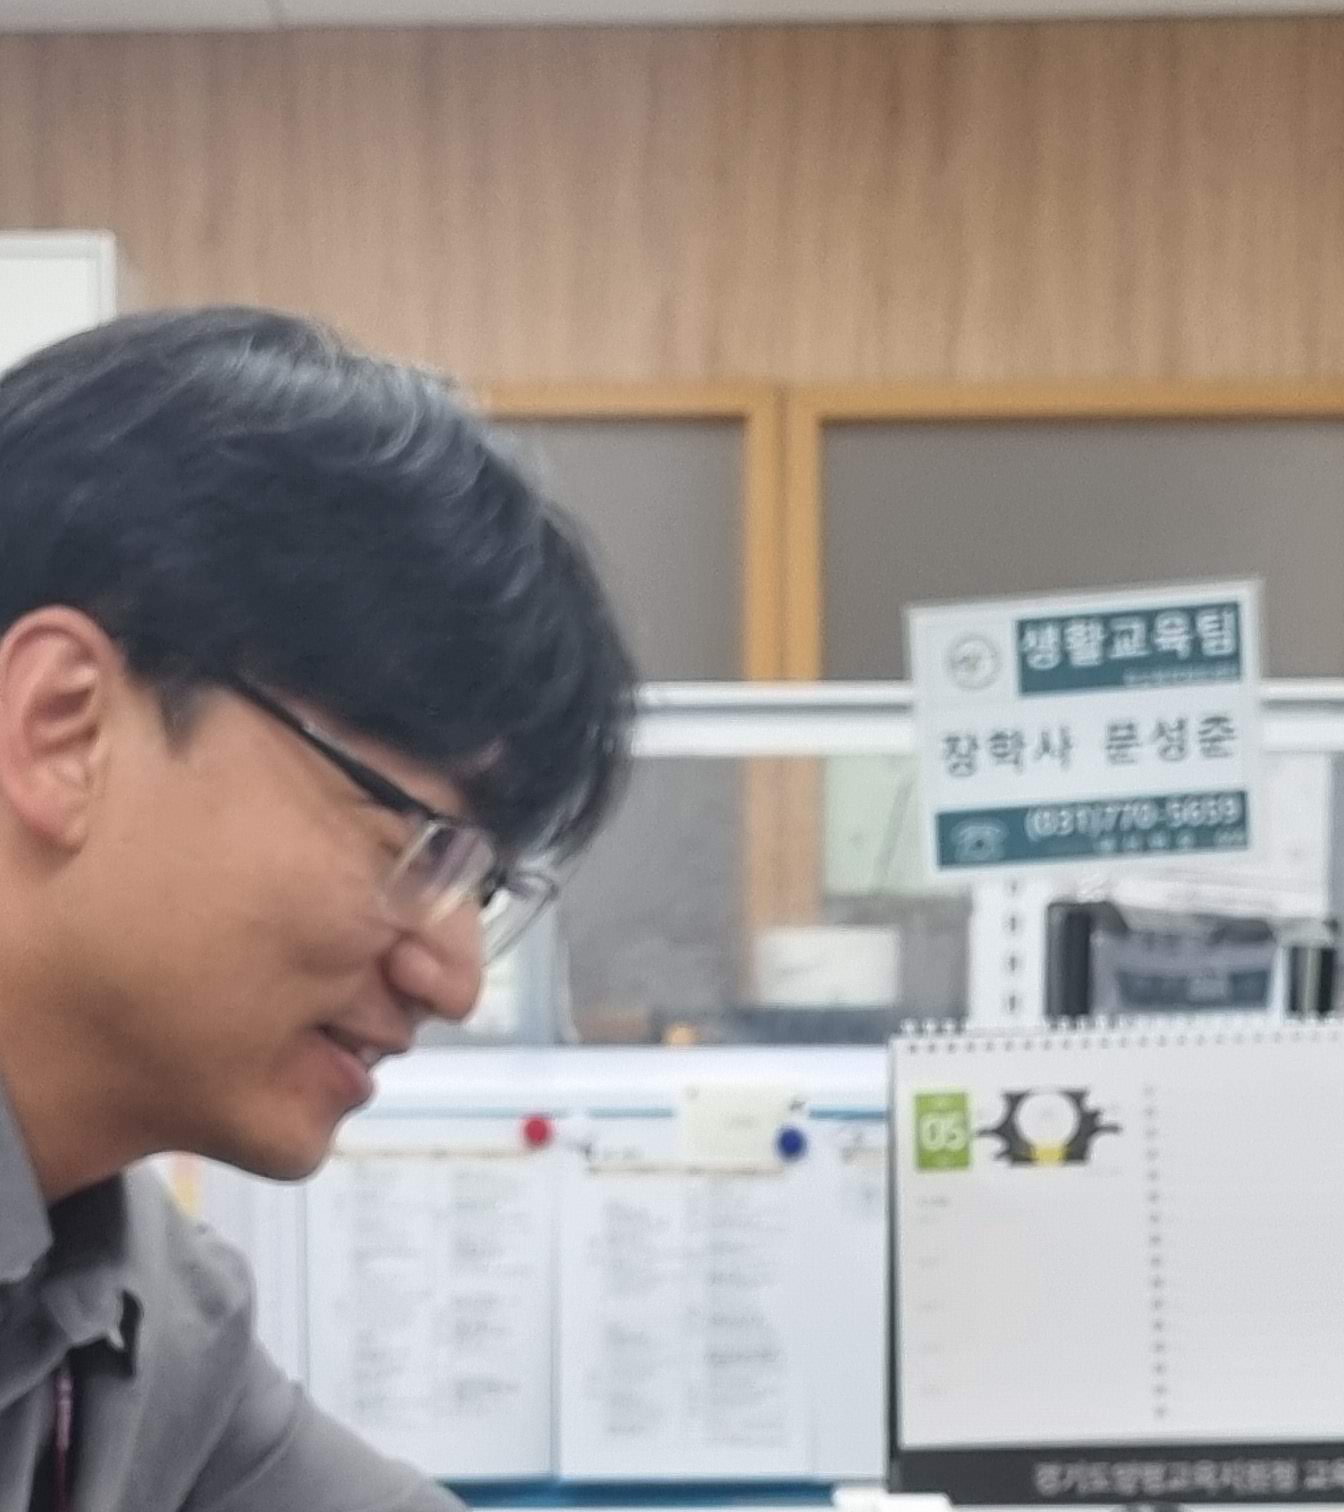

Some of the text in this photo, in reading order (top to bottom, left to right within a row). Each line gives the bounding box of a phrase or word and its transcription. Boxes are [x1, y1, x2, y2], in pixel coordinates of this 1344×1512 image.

[1020, 606, 1238, 670] 생활교육팀
[942, 714, 1238, 778] 장학사 문성준
[919, 1112, 967, 1151] 05
